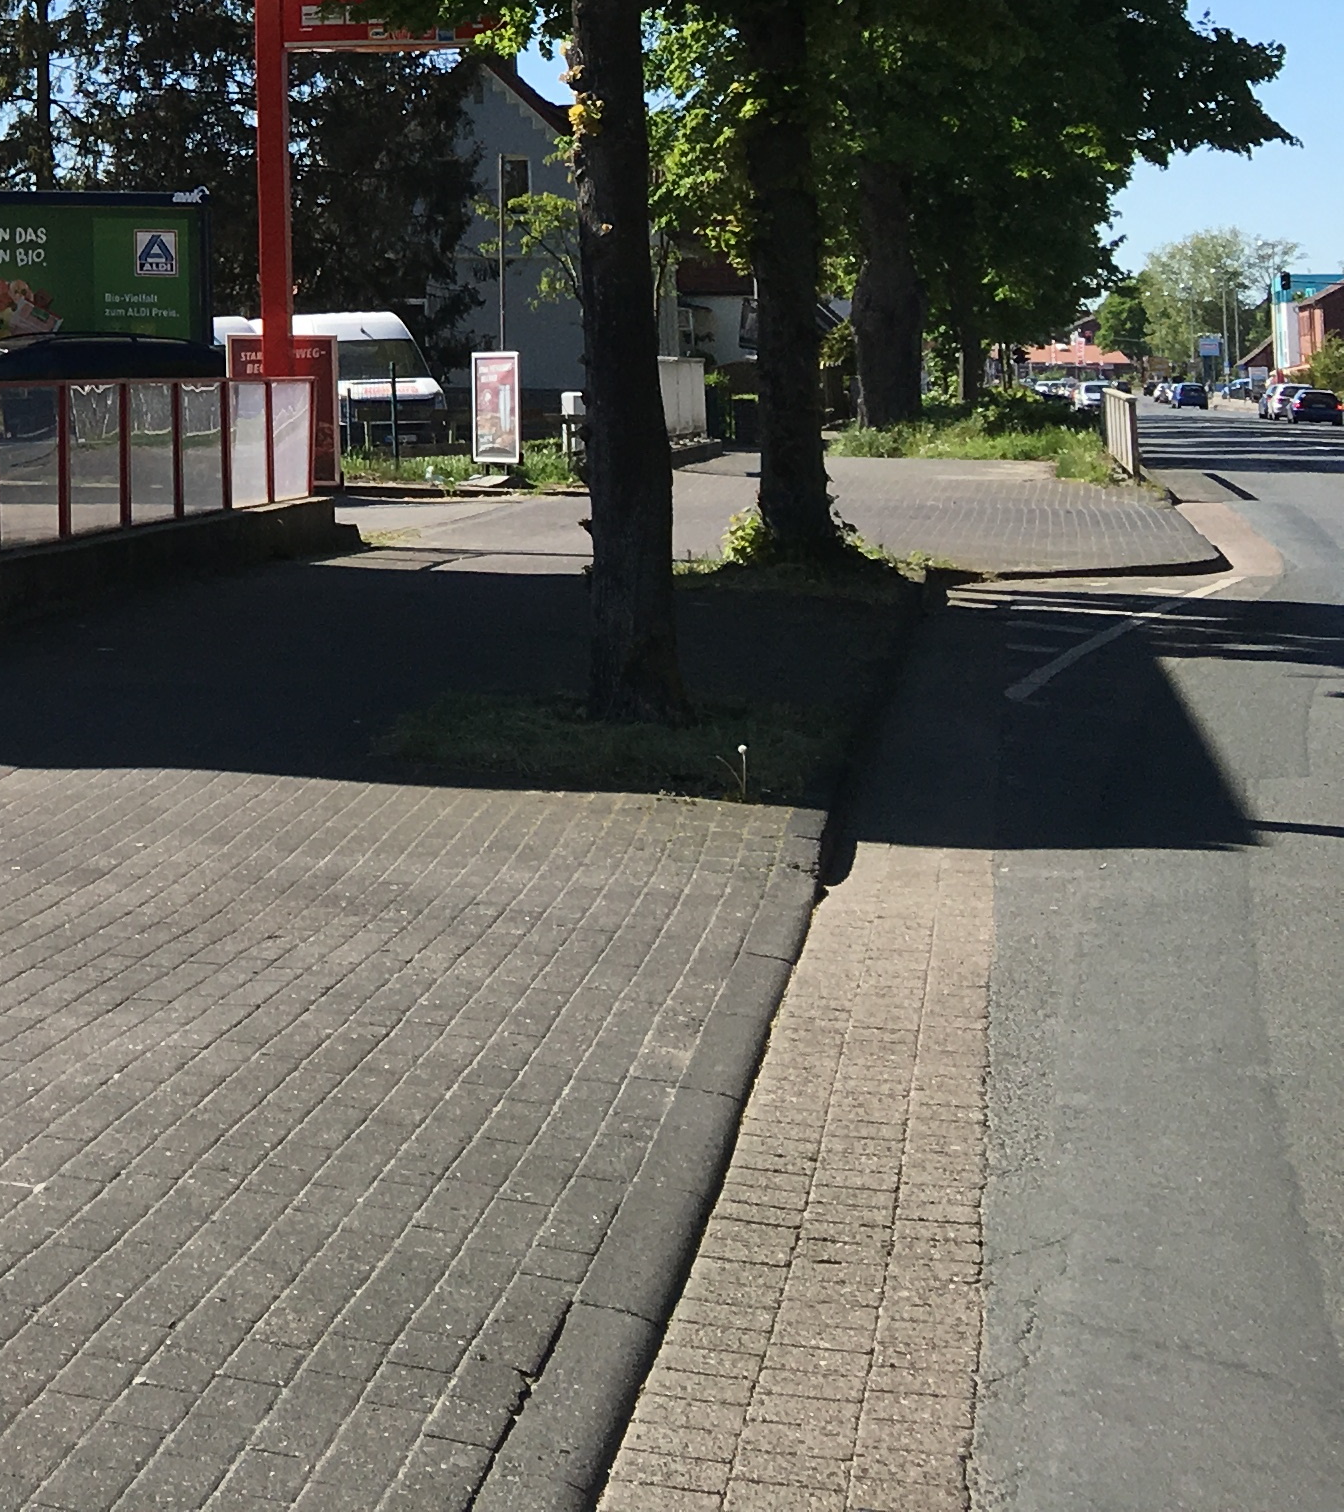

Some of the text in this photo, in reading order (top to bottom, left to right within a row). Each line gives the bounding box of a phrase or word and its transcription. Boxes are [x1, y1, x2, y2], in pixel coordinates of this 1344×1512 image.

[15, 226, 47, 245] DAS
[16, 247, 47, 267] BIO.
[143, 262, 172, 273] ALDI
[104, 292, 158, 304] Bio-Vielfalt
[104, 306, 180, 318] zum ALDI Preis.
[295, 347, 327, 360] WEG-
